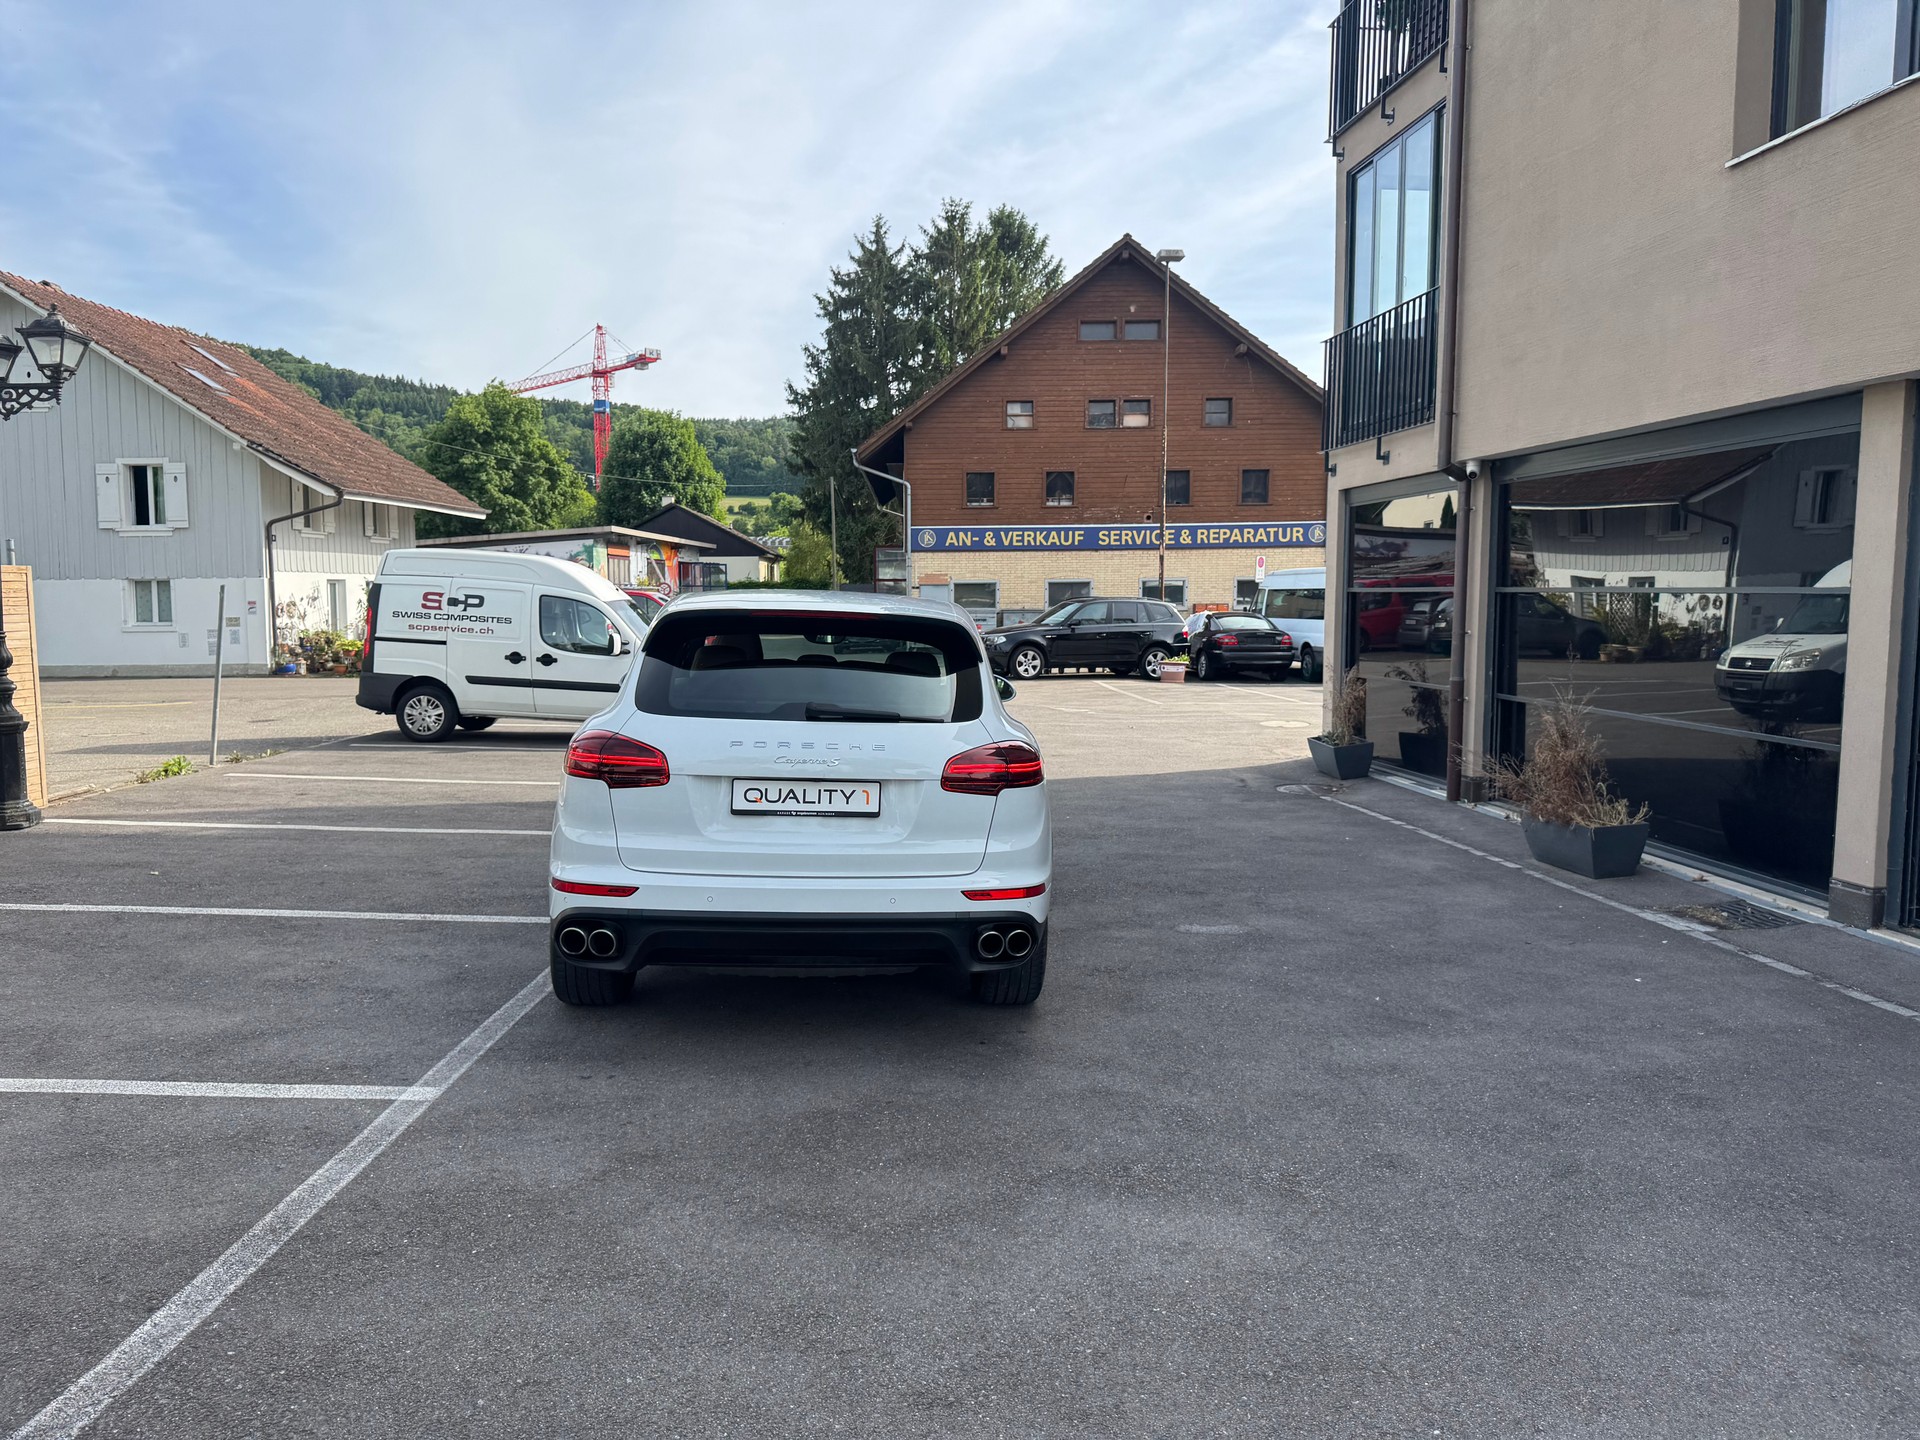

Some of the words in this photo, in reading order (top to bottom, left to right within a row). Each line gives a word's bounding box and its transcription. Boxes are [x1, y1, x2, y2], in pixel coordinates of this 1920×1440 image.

[945, 531, 979, 546] AN-
[984, 531, 996, 546] &
[1000, 530, 1085, 546] VERKAUF
[1098, 529, 1176, 546] SERVICE
[1180, 529, 1192, 544] &
[1197, 527, 1304, 544] REPARATUR
[392, 610, 432, 620] SWISS
[434, 613, 512, 625] COMPOSITES
[408, 623, 494, 635] scpservice.ch
[730, 740, 886, 751] PORSCHE
[774, 756, 828, 768] Cayenne
